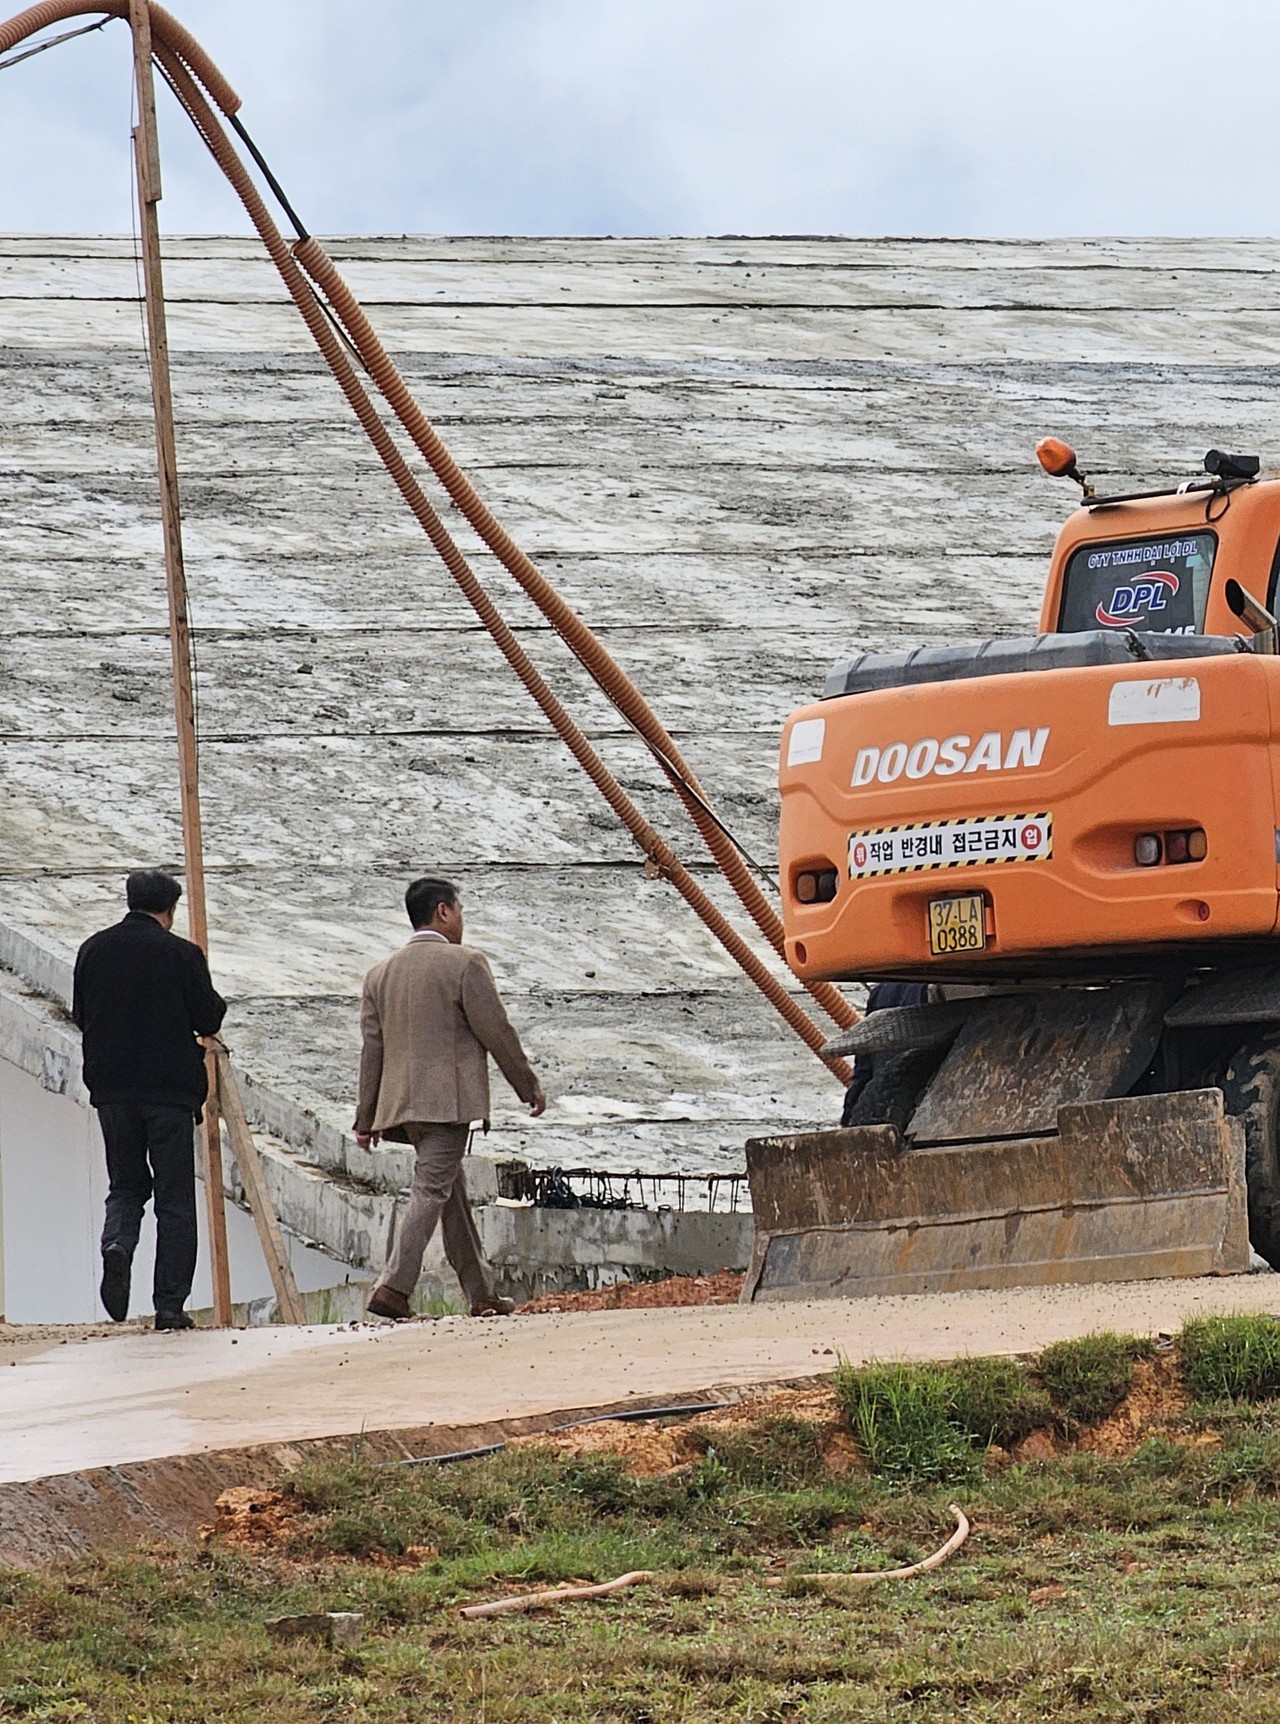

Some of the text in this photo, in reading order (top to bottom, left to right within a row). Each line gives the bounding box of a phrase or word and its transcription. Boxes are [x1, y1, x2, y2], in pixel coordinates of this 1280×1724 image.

[1112, 548, 1142, 566] TNHH
[1163, 541, 1182, 563] LỢI
[1108, 582, 1167, 615] DPL
[850, 727, 1050, 787] DOOSAN
[870, 840, 894, 863] 작업
[901, 834, 943, 859] 반경내
[952, 828, 1017, 854] 접근금지
[938, 925, 977, 951] 0388
